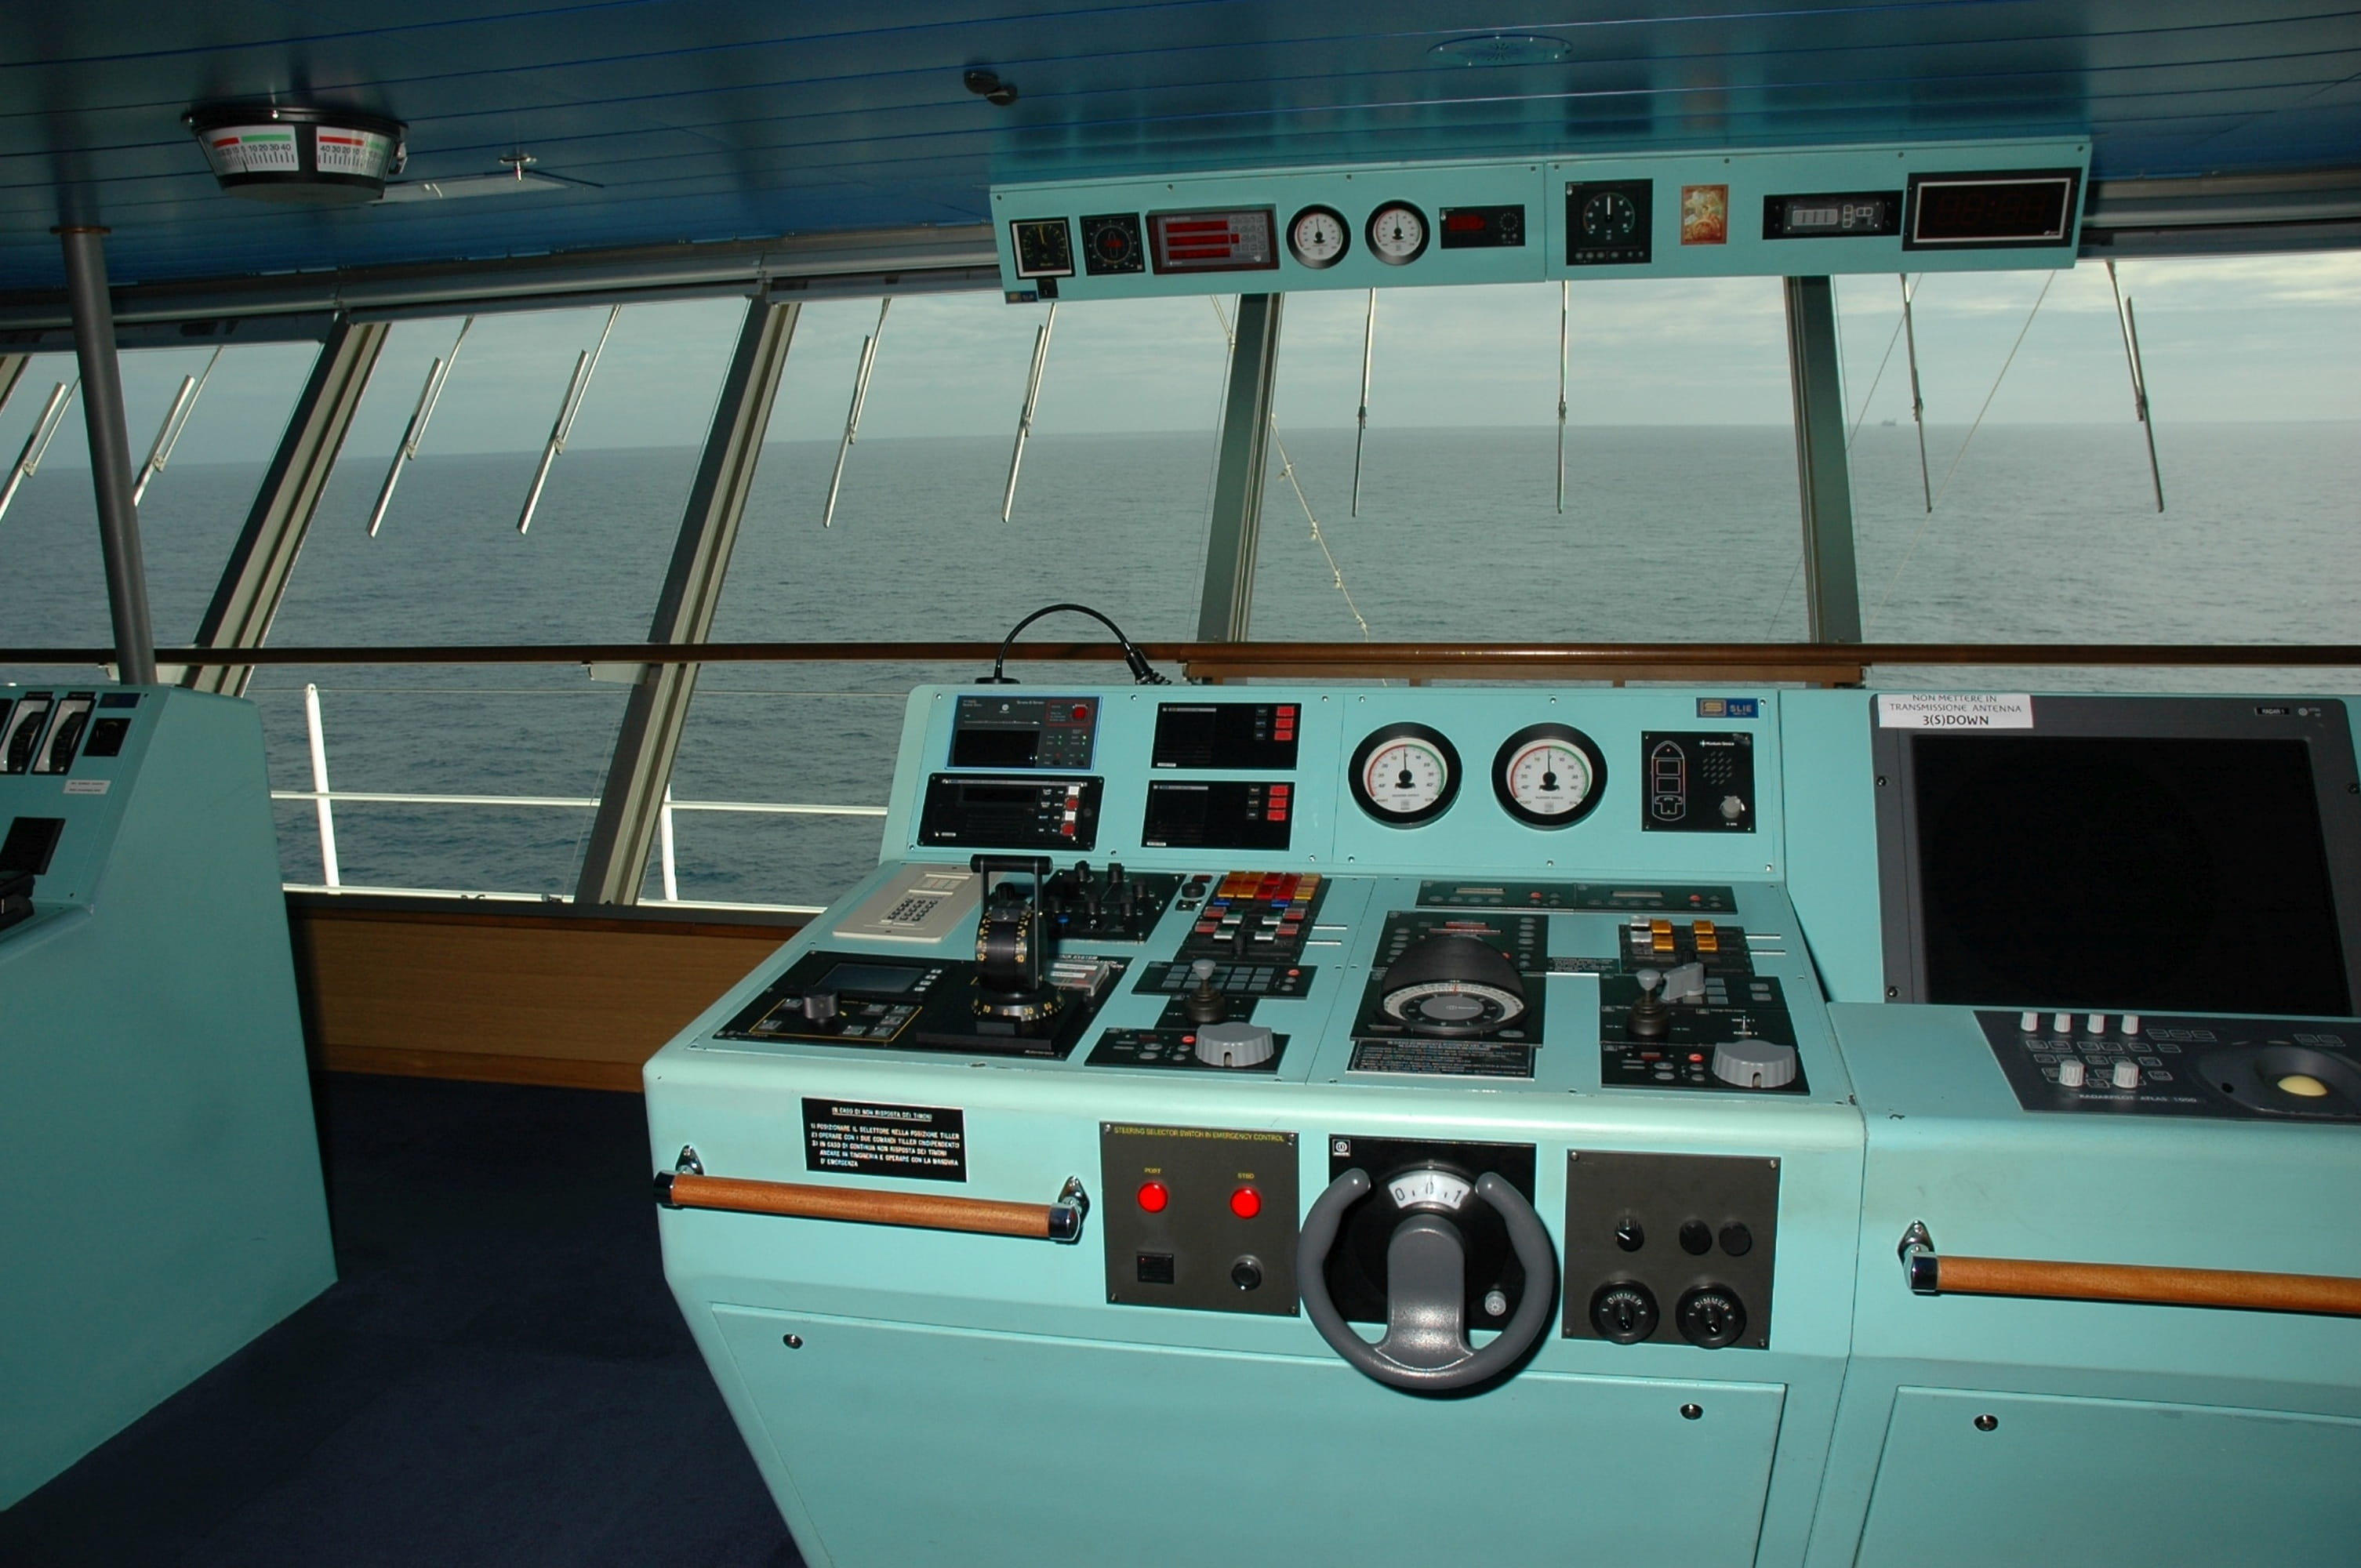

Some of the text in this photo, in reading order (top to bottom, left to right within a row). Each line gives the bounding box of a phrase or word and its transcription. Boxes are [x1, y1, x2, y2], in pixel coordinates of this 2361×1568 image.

[1890, 703, 2021, 713] TRANSMISSIONE ANTENNA
[1923, 714, 1989, 726] 3(S)DOWN
[875, 1109, 901, 1118] RISPOSTA
[816, 1123, 851, 1132] POSIZIONARE
[859, 1126, 889, 1135] SELETTORE
[910, 1130, 939, 1138] POSIZIONE
[940, 1131, 960, 1140] TILLER
[1179, 1129, 1204, 1138] SWITCH
[1212, 1131, 1252, 1140] EMERGENCY
[1253, 1133, 1284, 1142] CONTROL
[849, 1142, 876, 1151] CONTINUA
[885, 1154, 910, 1163] OPERARE
[932, 1158, 958, 1167] MANOVRA
[1607, 1293, 1642, 1306] DIMMER
[1694, 1297, 1730, 1310] DIMMER
